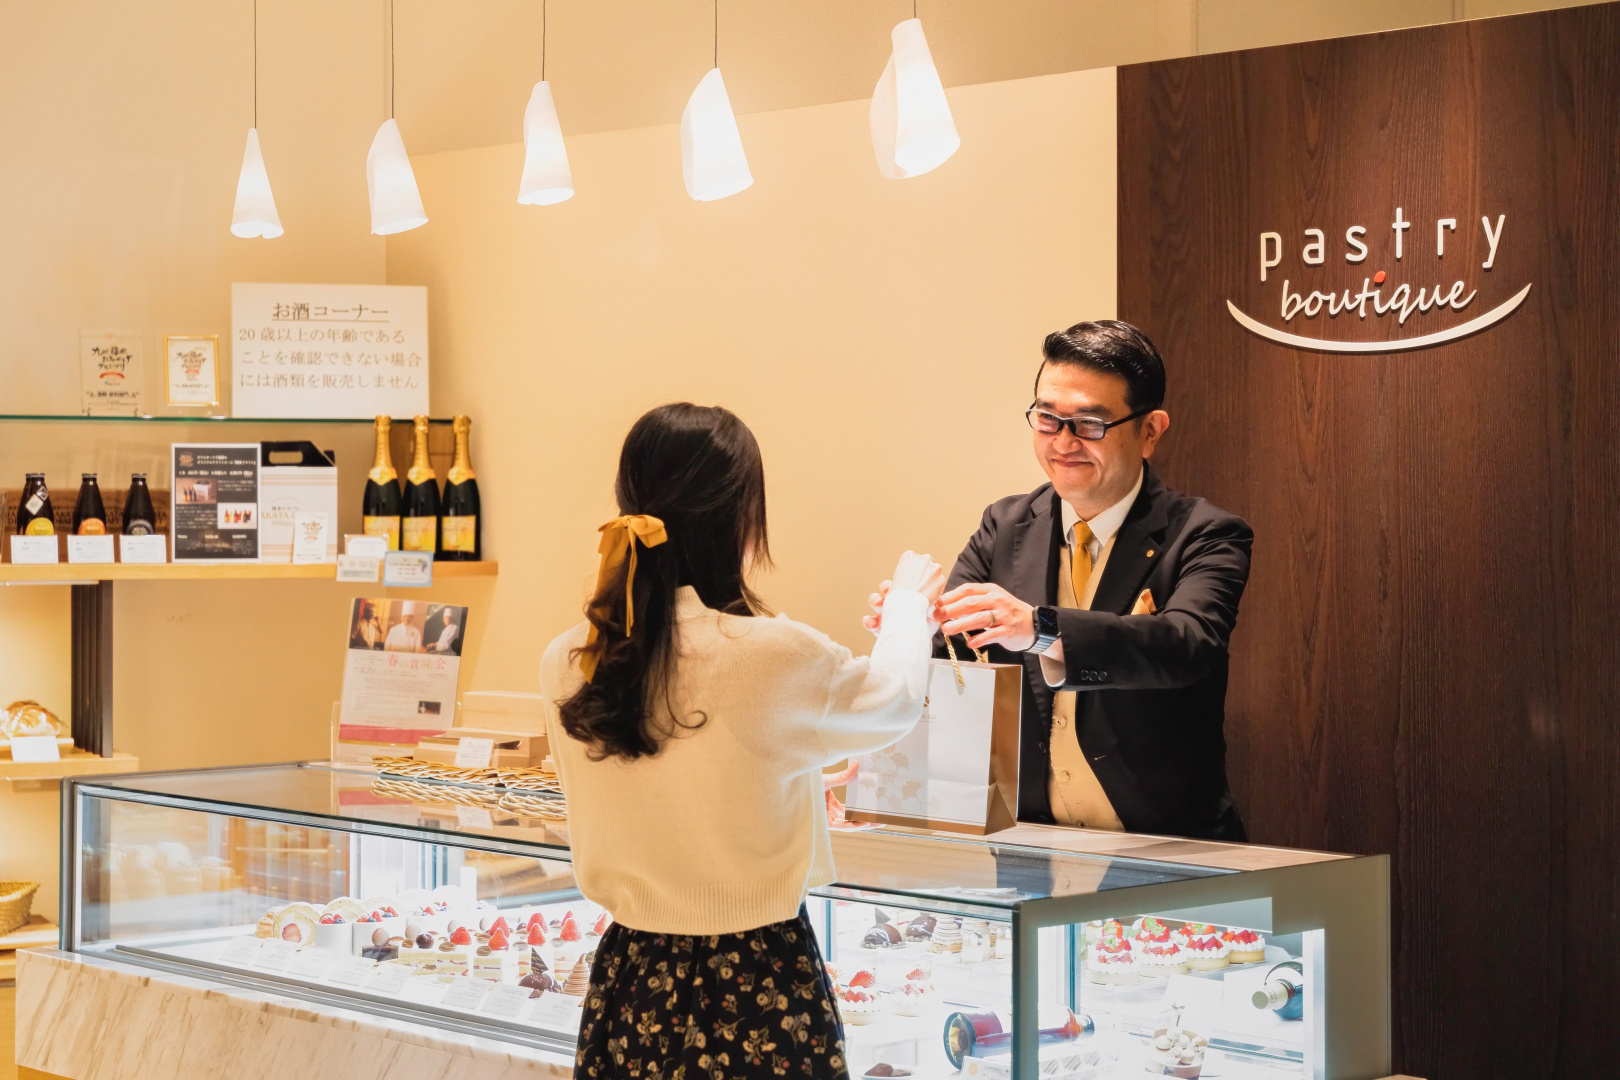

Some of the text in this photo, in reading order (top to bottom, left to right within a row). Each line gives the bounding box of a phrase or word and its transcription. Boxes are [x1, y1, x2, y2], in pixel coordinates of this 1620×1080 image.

[1260, 207, 1506, 281] pastry
[1281, 270, 1477, 324] boutique
[272, 302, 389, 320] お酒コーナー
[241, 350, 422, 367] ことを確認できない場合
[240, 372, 419, 389] には酒類を販売しません
